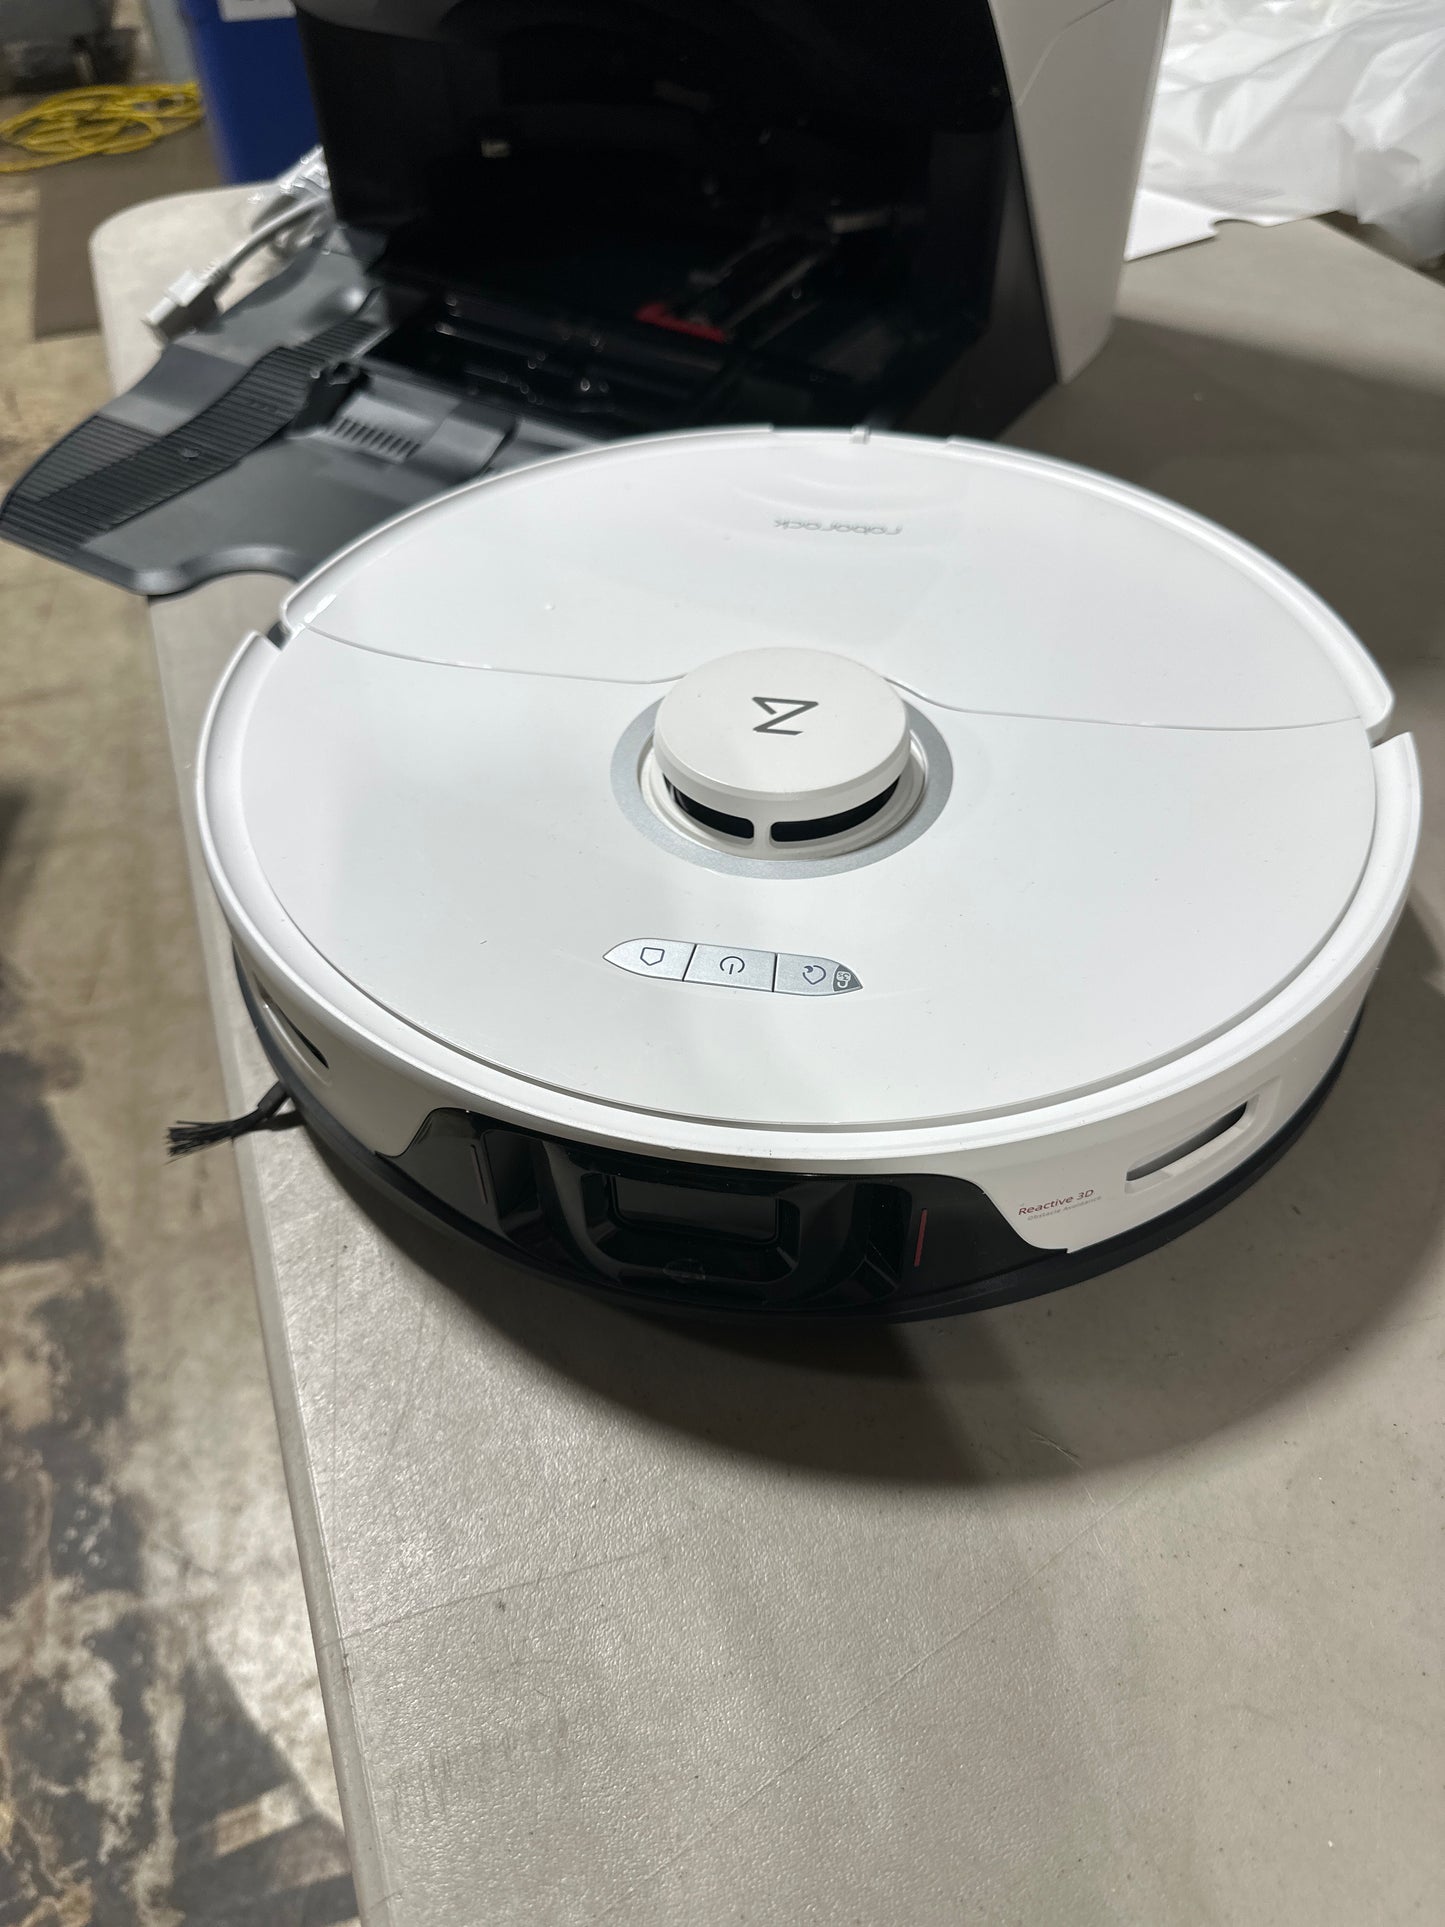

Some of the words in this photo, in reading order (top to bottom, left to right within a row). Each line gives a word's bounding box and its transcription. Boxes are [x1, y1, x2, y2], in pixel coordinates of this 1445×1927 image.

[774, 520, 901, 535] roborock
[1018, 1197, 1073, 1215] Reactive
[1076, 1189, 1094, 1200] 3D
